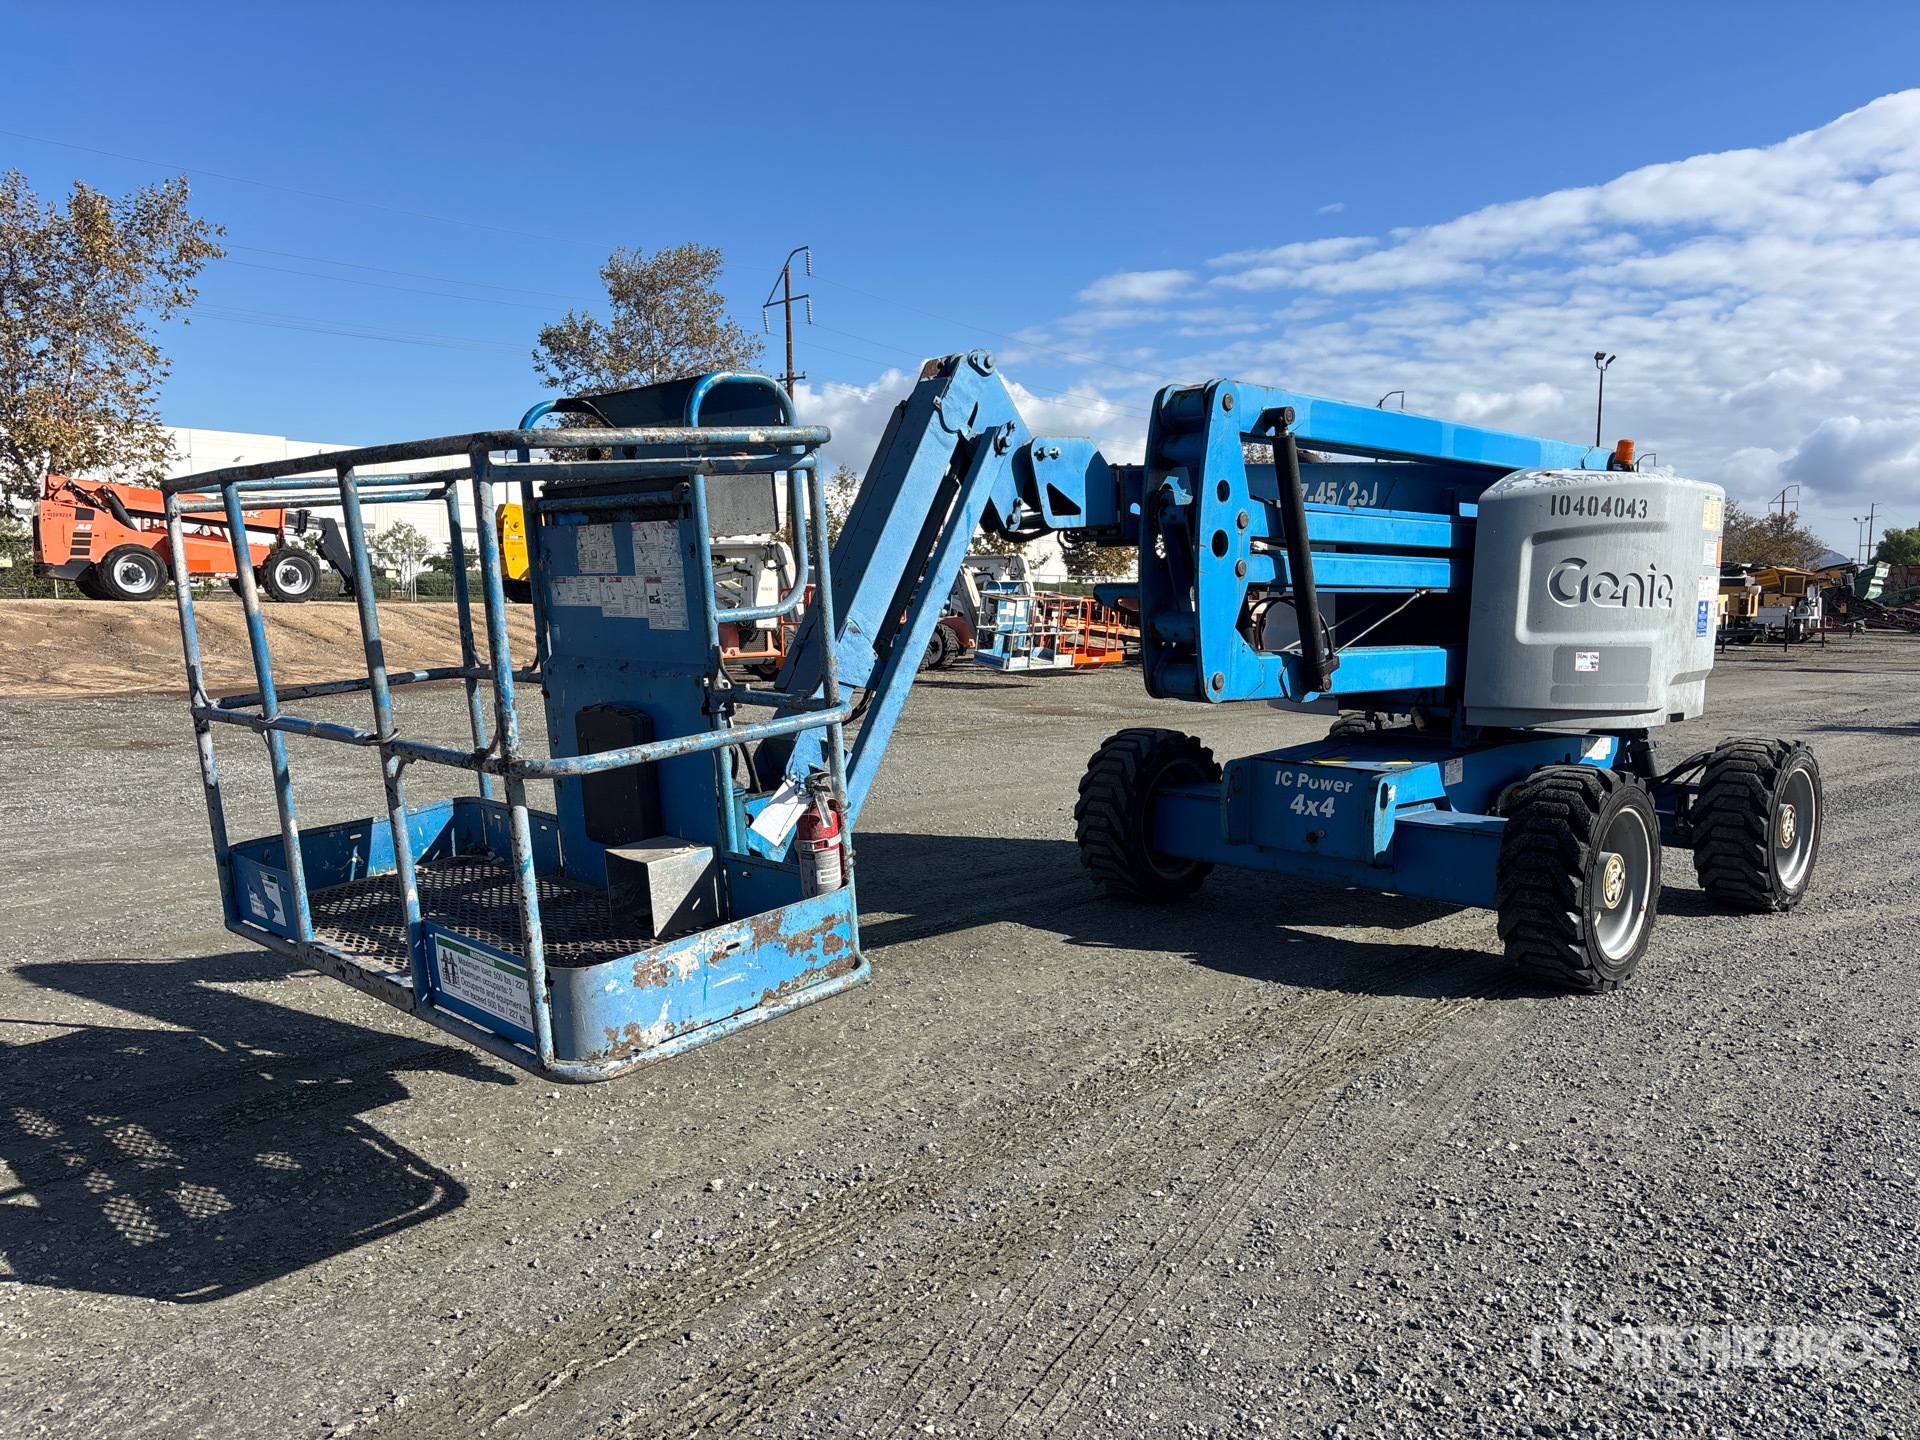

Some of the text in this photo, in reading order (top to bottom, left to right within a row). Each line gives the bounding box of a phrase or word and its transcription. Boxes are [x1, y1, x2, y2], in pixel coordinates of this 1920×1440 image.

[1550, 494, 1648, 519] 10404043
[75, 523, 93, 531] JLG
[1546, 557, 1674, 609] Genie
[1275, 770, 1354, 794] IC Power
[1290, 793, 1336, 819] 4x4
[458, 955, 480, 971] Maximum
[493, 970, 503, 981] 500
[504, 975, 512, 985] lbs
[515, 980, 524, 990] 227
[459, 966, 481, 981] Maximum
[482, 978, 508, 993] occupants:
[461, 977, 485, 994] Occupants
[486, 989, 496, 999] and
[497, 994, 522, 1010] equipment
[462, 988, 470, 997] not
[470, 992, 487, 1005] exceed
[487, 998, 497, 1009] 500
[509, 1009, 518, 1019] 227
